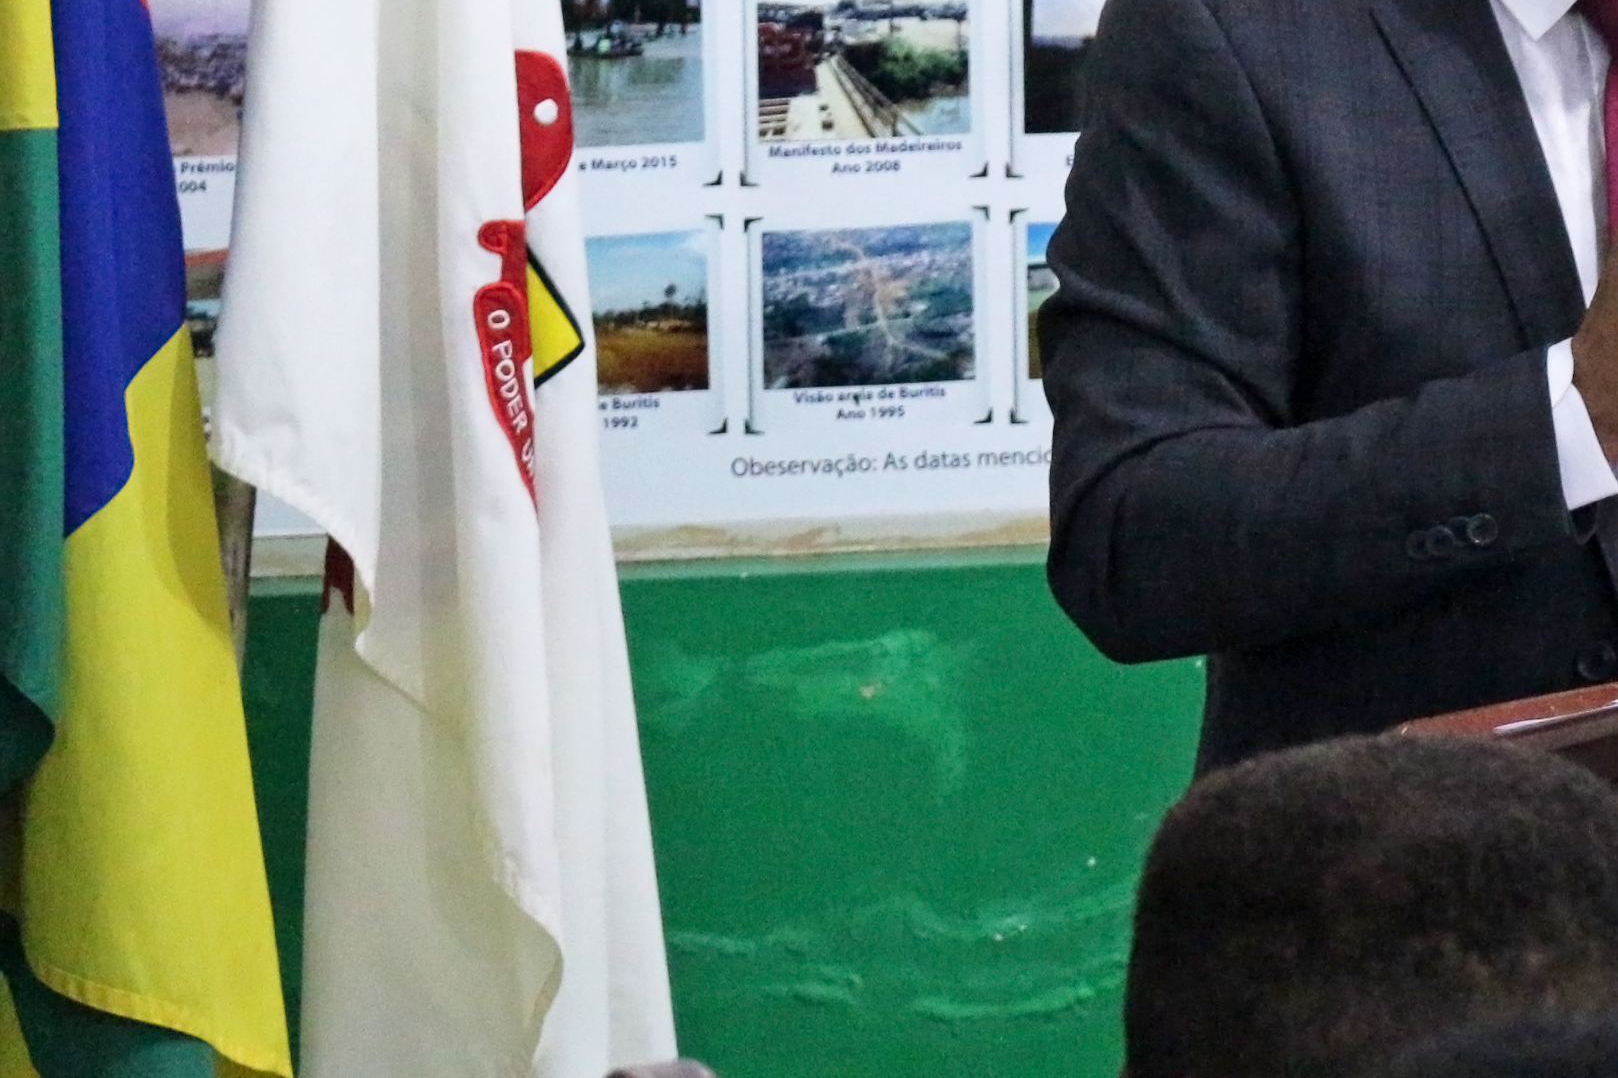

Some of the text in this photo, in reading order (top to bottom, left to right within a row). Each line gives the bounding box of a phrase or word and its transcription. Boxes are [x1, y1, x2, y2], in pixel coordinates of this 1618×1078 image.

[769, 136, 961, 157] Manifesto dos Madeireiros
[181, 158, 235, 174] Prêmio
[591, 154, 636, 172] Março
[833, 159, 860, 174] Ano
[487, 309, 528, 435] O PODER
[613, 394, 659, 410] Buritis
[794, 384, 945, 403] Visão de Buritis
[837, 404, 865, 419] Ano
[731, 443, 1050, 480] Obeservação: As datas mencio
